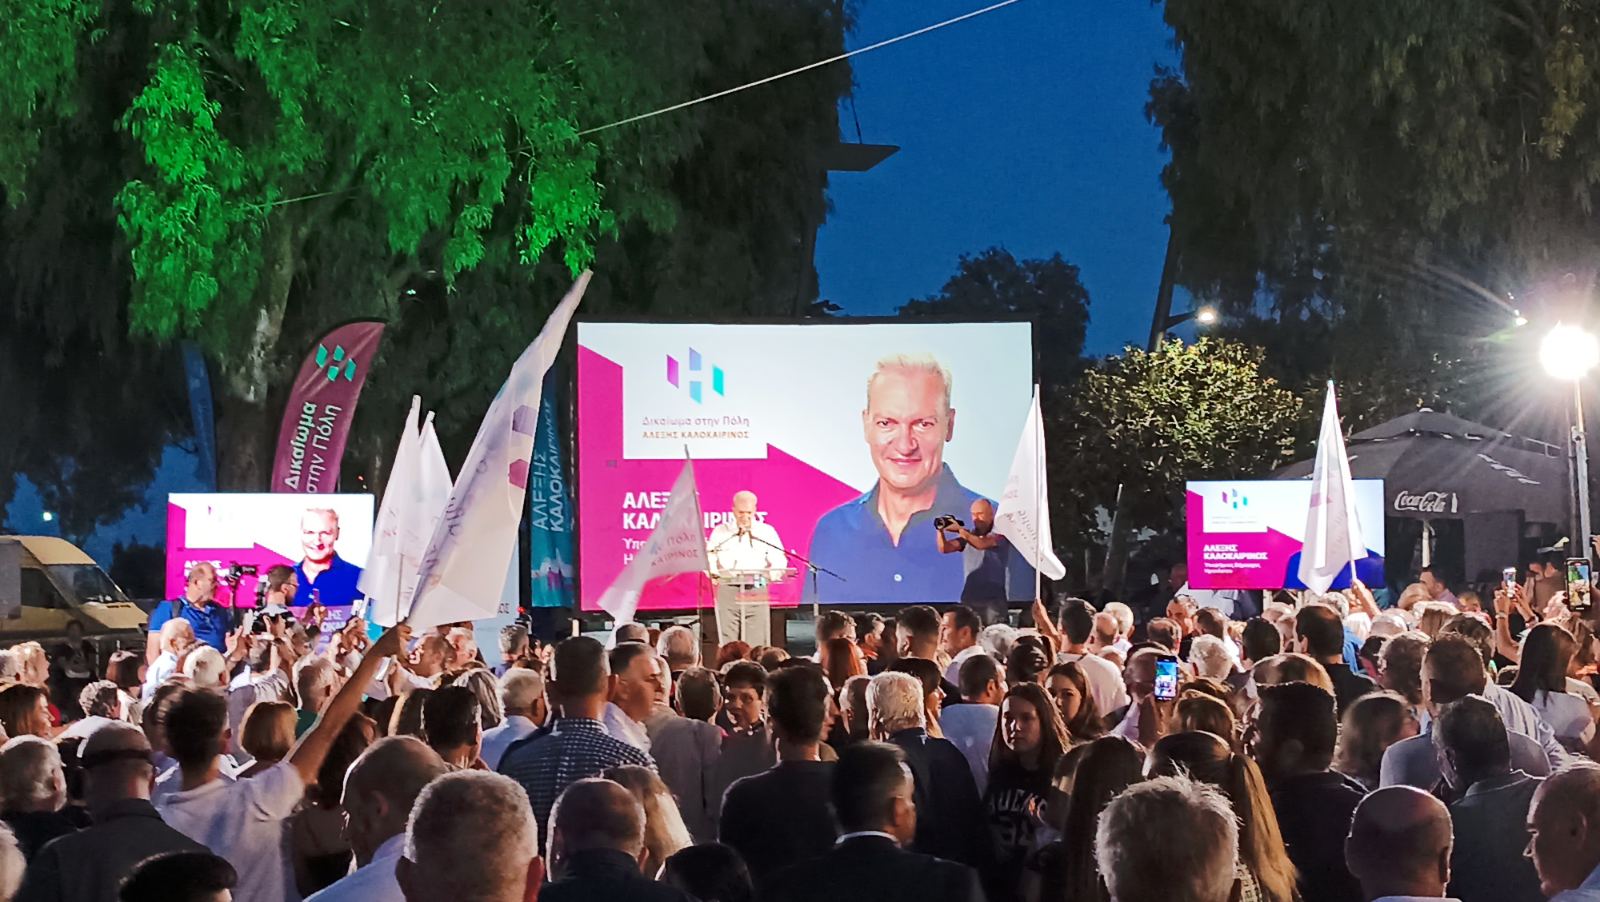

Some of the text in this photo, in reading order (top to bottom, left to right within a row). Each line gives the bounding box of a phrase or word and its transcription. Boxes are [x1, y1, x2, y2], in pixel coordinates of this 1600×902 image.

[312, 404, 343, 450] Πόλη
[642, 431, 678, 439] ΑΛΕΞΗΣ
[694, 417, 720, 427] στην
[723, 415, 750, 427] Πόλη
[284, 401, 318, 490] Δικαίωμα
[532, 450, 550, 531] ΑΛΕΞΗΣ
